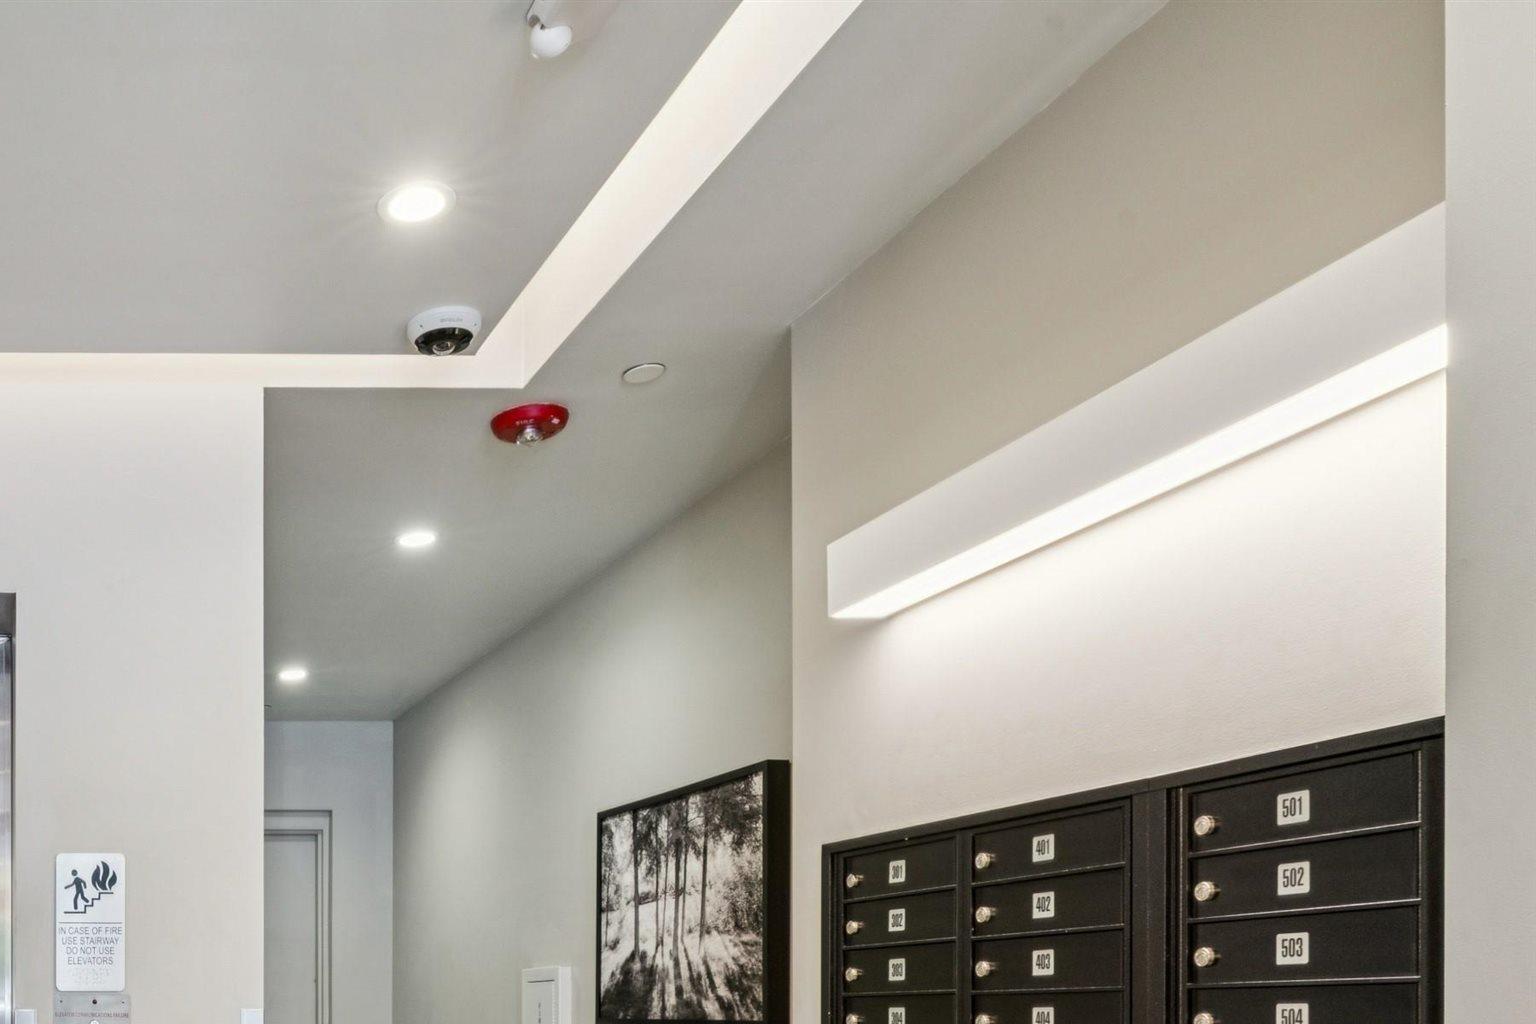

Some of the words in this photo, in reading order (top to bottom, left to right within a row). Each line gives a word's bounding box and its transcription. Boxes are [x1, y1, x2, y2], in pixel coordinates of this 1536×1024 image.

[1282, 796, 1302, 818] 501
[1035, 838, 1050, 856] 401
[891, 864, 903, 880] 301
[1283, 867, 1304, 887] 502
[1035, 895, 1052, 913] 402
[890, 912, 904, 928] 302
[58, 926, 66, 935] IN
[68, 926, 90, 935] CASE
[91, 926, 103, 935] OF
[104, 926, 123, 935] FIRE
[61, 936, 78, 946] USE
[80, 936, 120, 946] STAIRWAY
[1281, 938, 1303, 958] 503
[66, 946, 79, 955] DO
[80, 946, 97, 955] NOT
[98, 946, 115, 955] USE
[67, 956, 114, 966] ELEVATORS
[1035, 952, 1052, 970] 403
